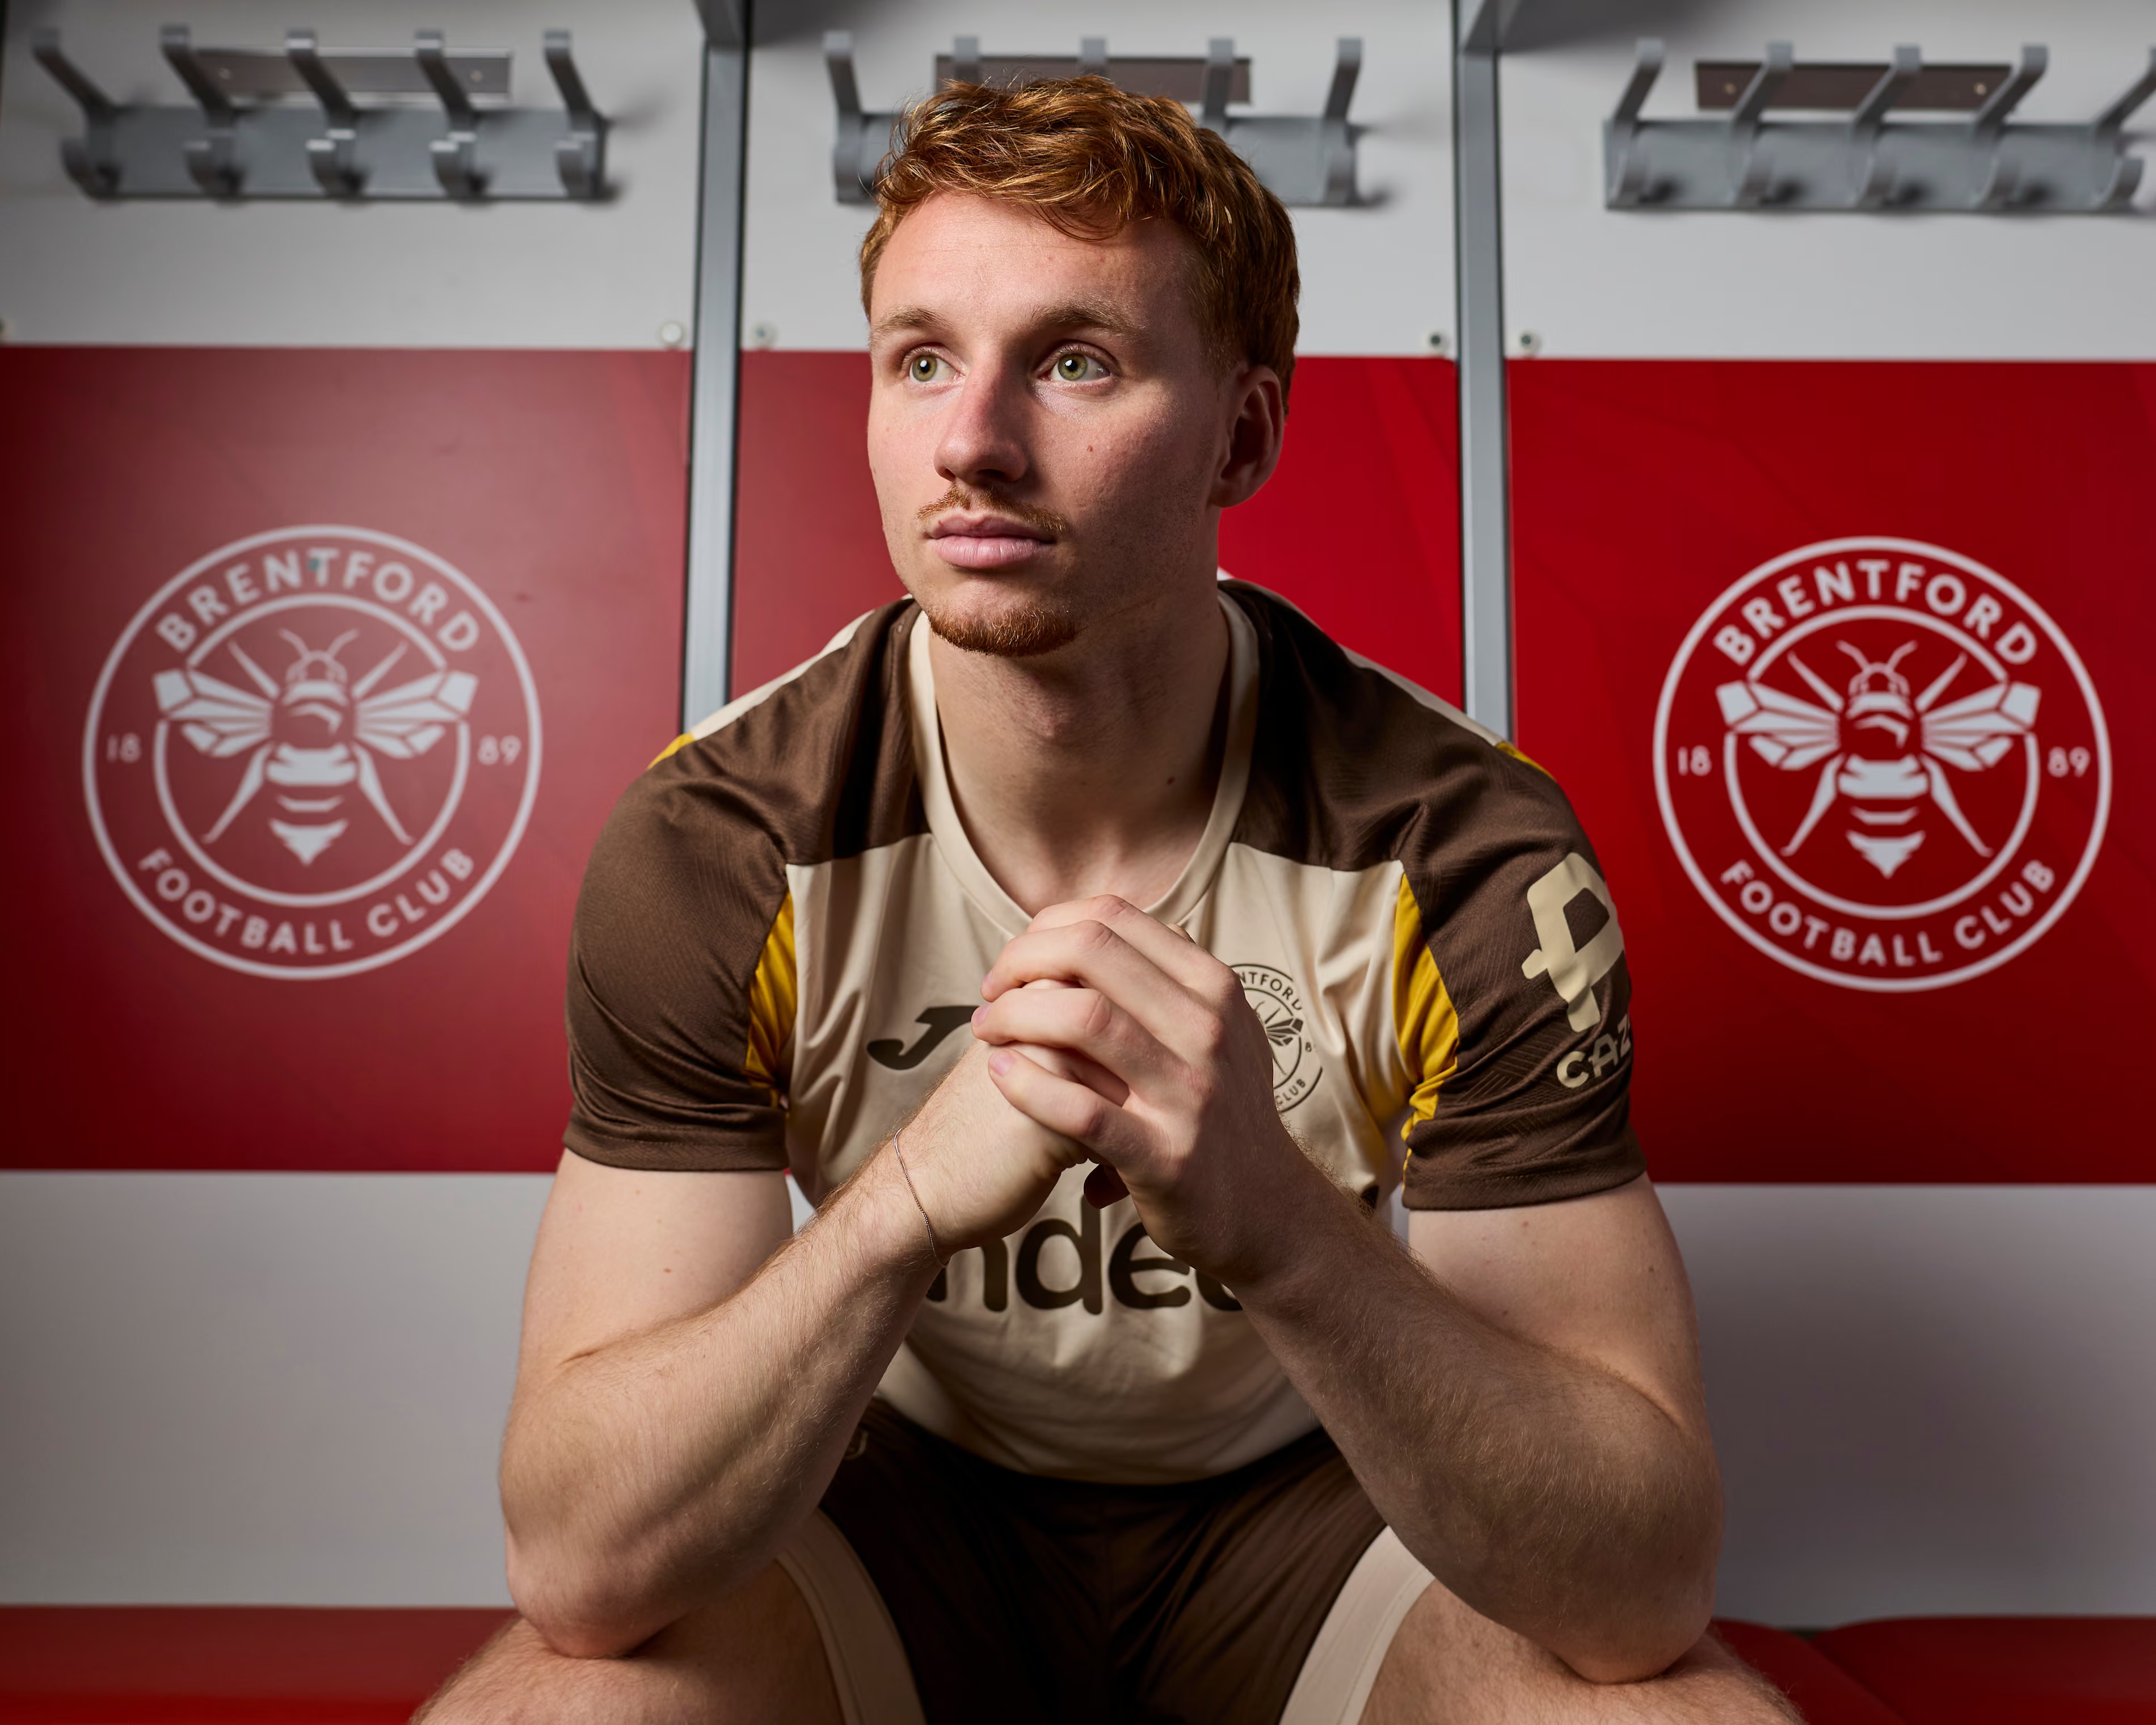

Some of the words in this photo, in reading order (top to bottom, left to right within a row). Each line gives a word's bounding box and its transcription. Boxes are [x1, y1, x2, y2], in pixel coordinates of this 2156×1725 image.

[155, 548, 479, 652] BRENTFORD
[1713, 559, 2039, 666] BRENTFORD
[107, 734, 141, 763] 18
[478, 735, 521, 765] 89
[1678, 745, 1712, 776] 18
[2047, 747, 2091, 778] 89
[140, 848, 353, 954] FOOTBALL
[367, 848, 474, 937] CLUB
[1721, 861, 1943, 967] FOOTBALL
[1954, 861, 2055, 950] CLUB
